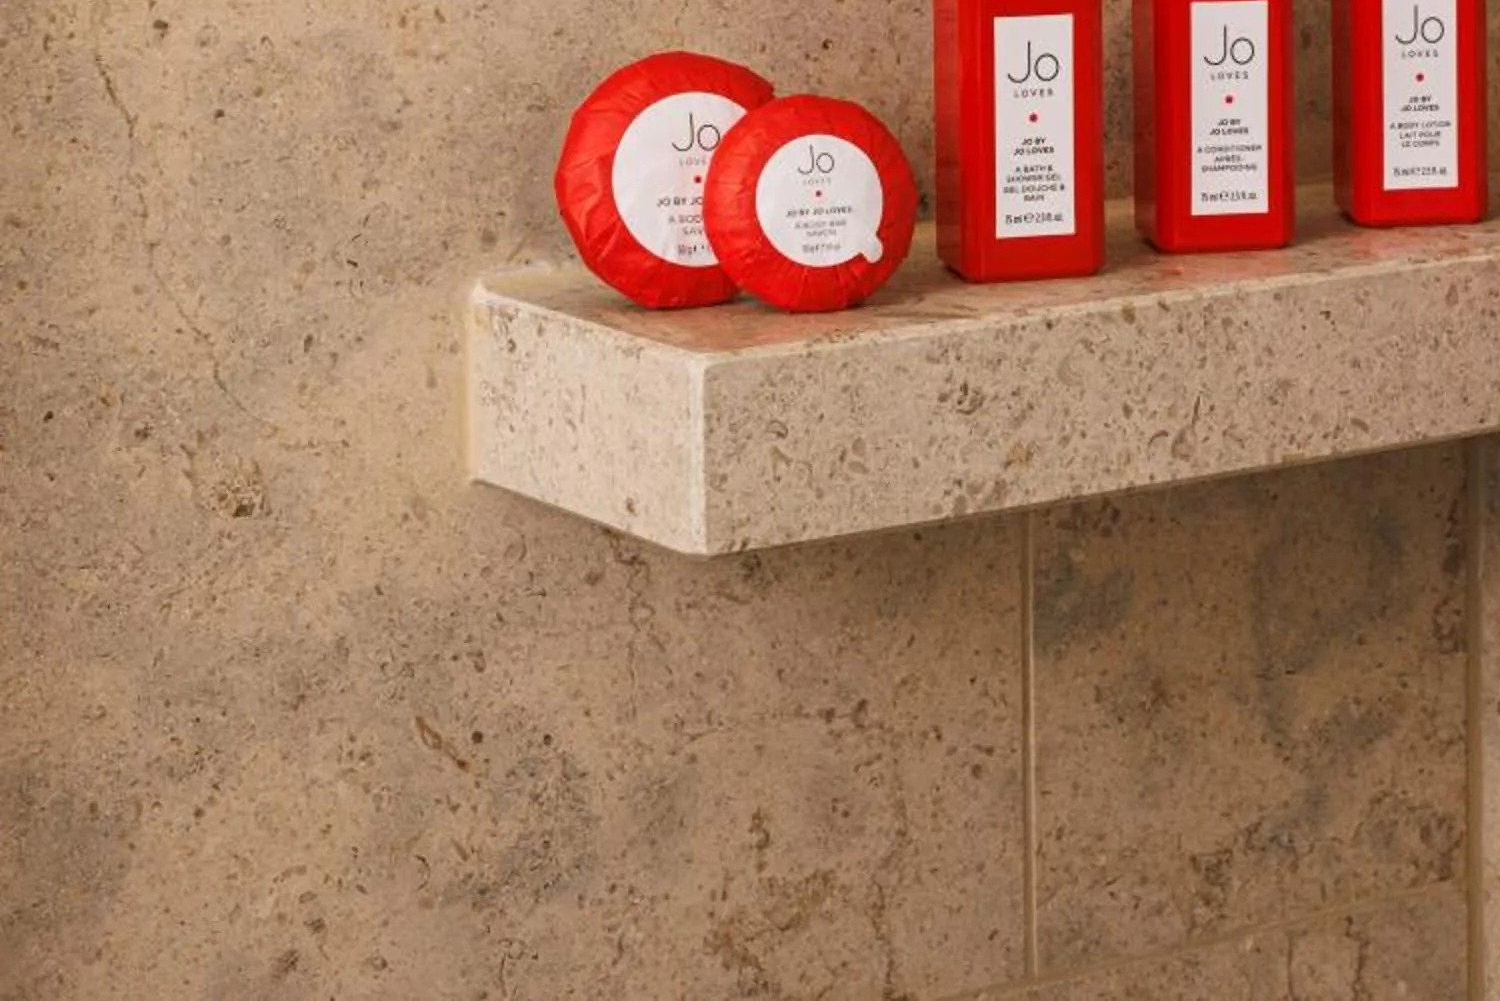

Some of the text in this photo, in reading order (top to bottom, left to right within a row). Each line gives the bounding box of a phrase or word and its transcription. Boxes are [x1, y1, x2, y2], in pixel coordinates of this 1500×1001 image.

[1394, 4, 1445, 45] Jo
[1203, 25, 1255, 67] Jo
[1401, 48, 1439, 59] LOVES
[1007, 40, 1059, 84] Jo
[1210, 70, 1249, 82] LOVES
[1013, 87, 1054, 98] LOVES
[671, 111, 721, 152] Jo
[797, 144, 835, 175] Jo
[1027, 146, 1055, 155] LOVES
[678, 156, 707, 167] LOVE
